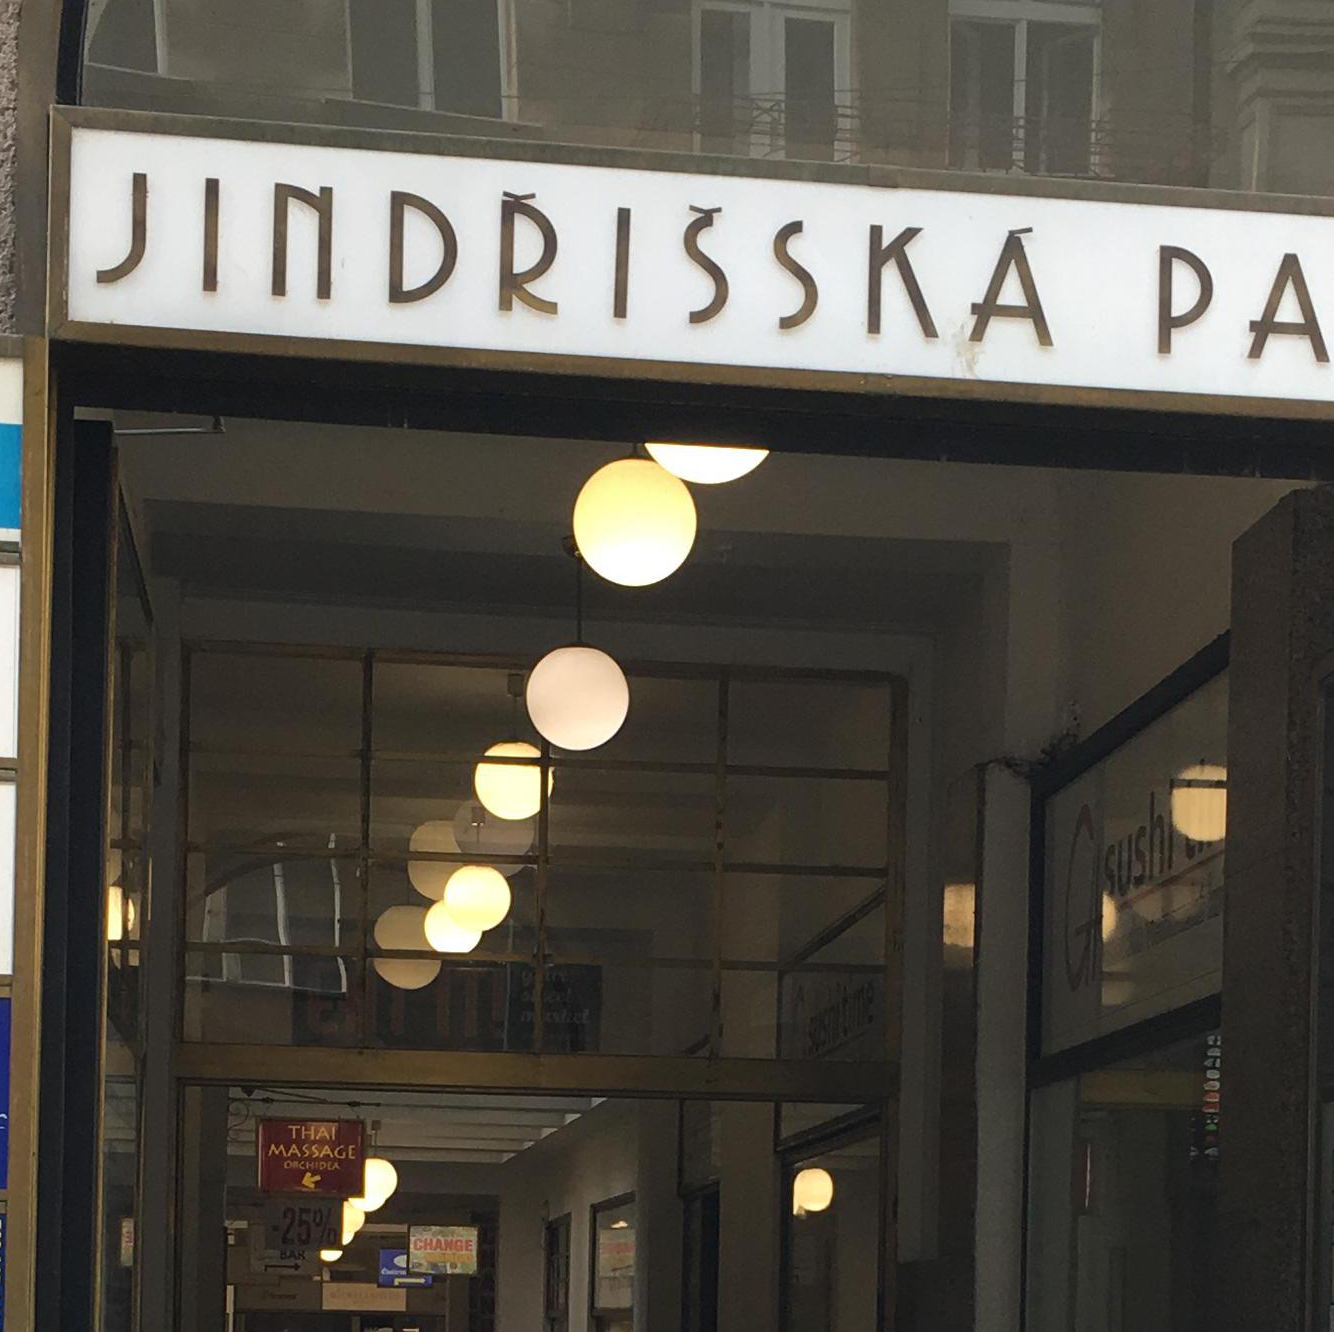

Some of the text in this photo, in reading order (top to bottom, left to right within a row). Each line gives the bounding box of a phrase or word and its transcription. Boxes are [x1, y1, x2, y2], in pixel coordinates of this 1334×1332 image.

[96, 172, 1053, 347] JINDŘIŠSKÁ
[287, 1124, 337, 1142] THAI
[268, 1144, 356, 1160] MASSAGE
[271, 1207, 338, 1247] -25%
[412, 1238, 474, 1252] CHANGE
